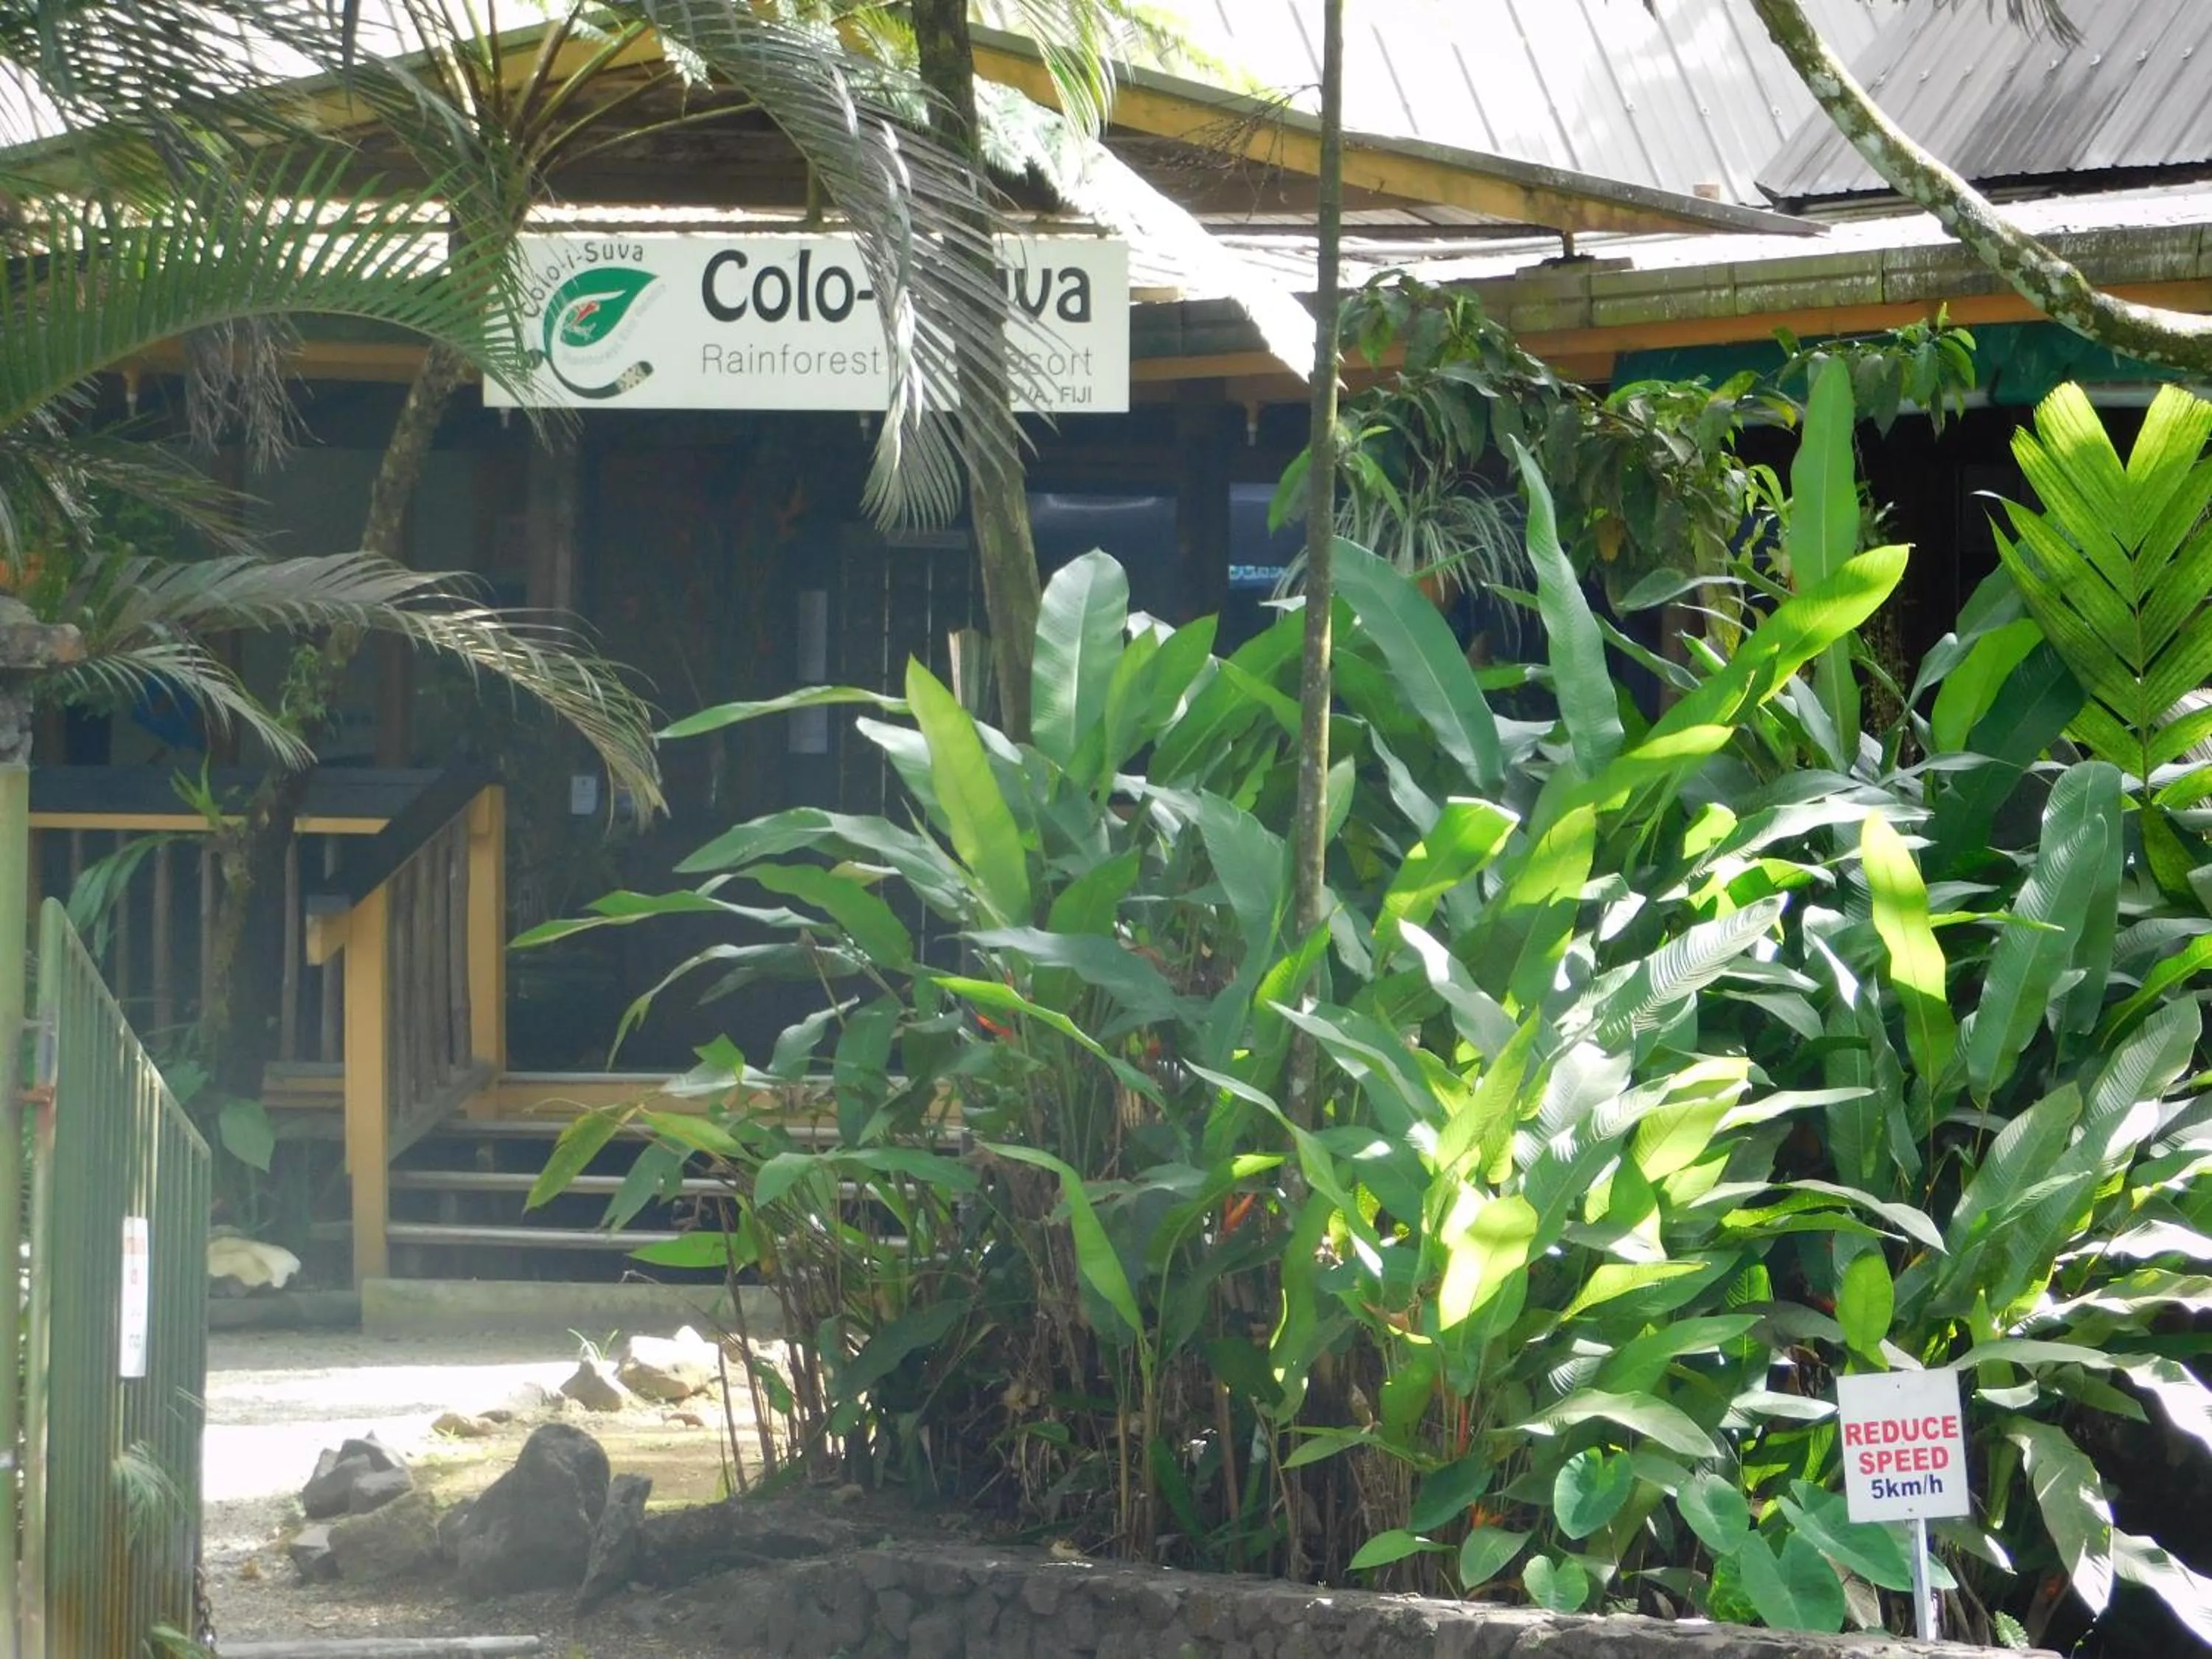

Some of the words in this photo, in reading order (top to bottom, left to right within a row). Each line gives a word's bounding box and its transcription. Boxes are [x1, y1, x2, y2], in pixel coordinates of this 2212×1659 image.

[702, 343, 880, 375] Rainforest
[1007, 347, 1093, 375] esort
[1060, 386, 1092, 403] FIJI
[1844, 1415, 1958, 1447] REDUCE
[1859, 1446, 1949, 1475] SPEED
[1871, 1474, 1944, 1500] 5km/h
